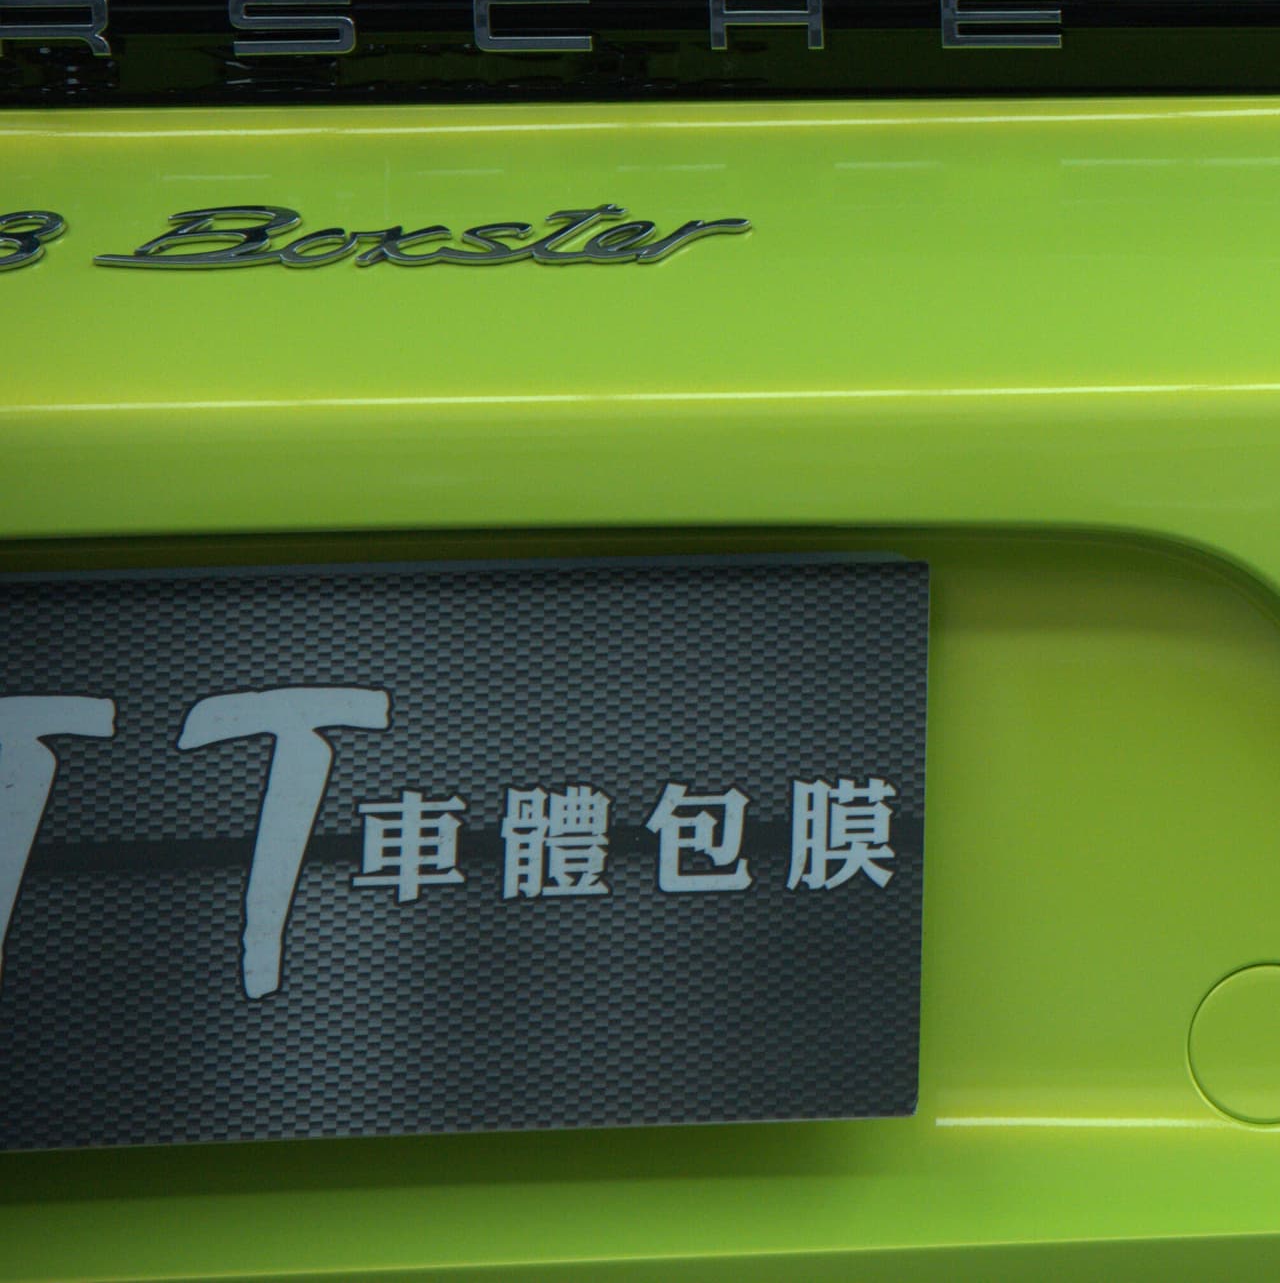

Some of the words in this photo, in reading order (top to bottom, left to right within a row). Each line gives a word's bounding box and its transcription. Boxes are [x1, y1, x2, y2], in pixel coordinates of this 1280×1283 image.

[93, 203, 752, 269] Boxster
[352, 778, 898, 904] 車體包膜
